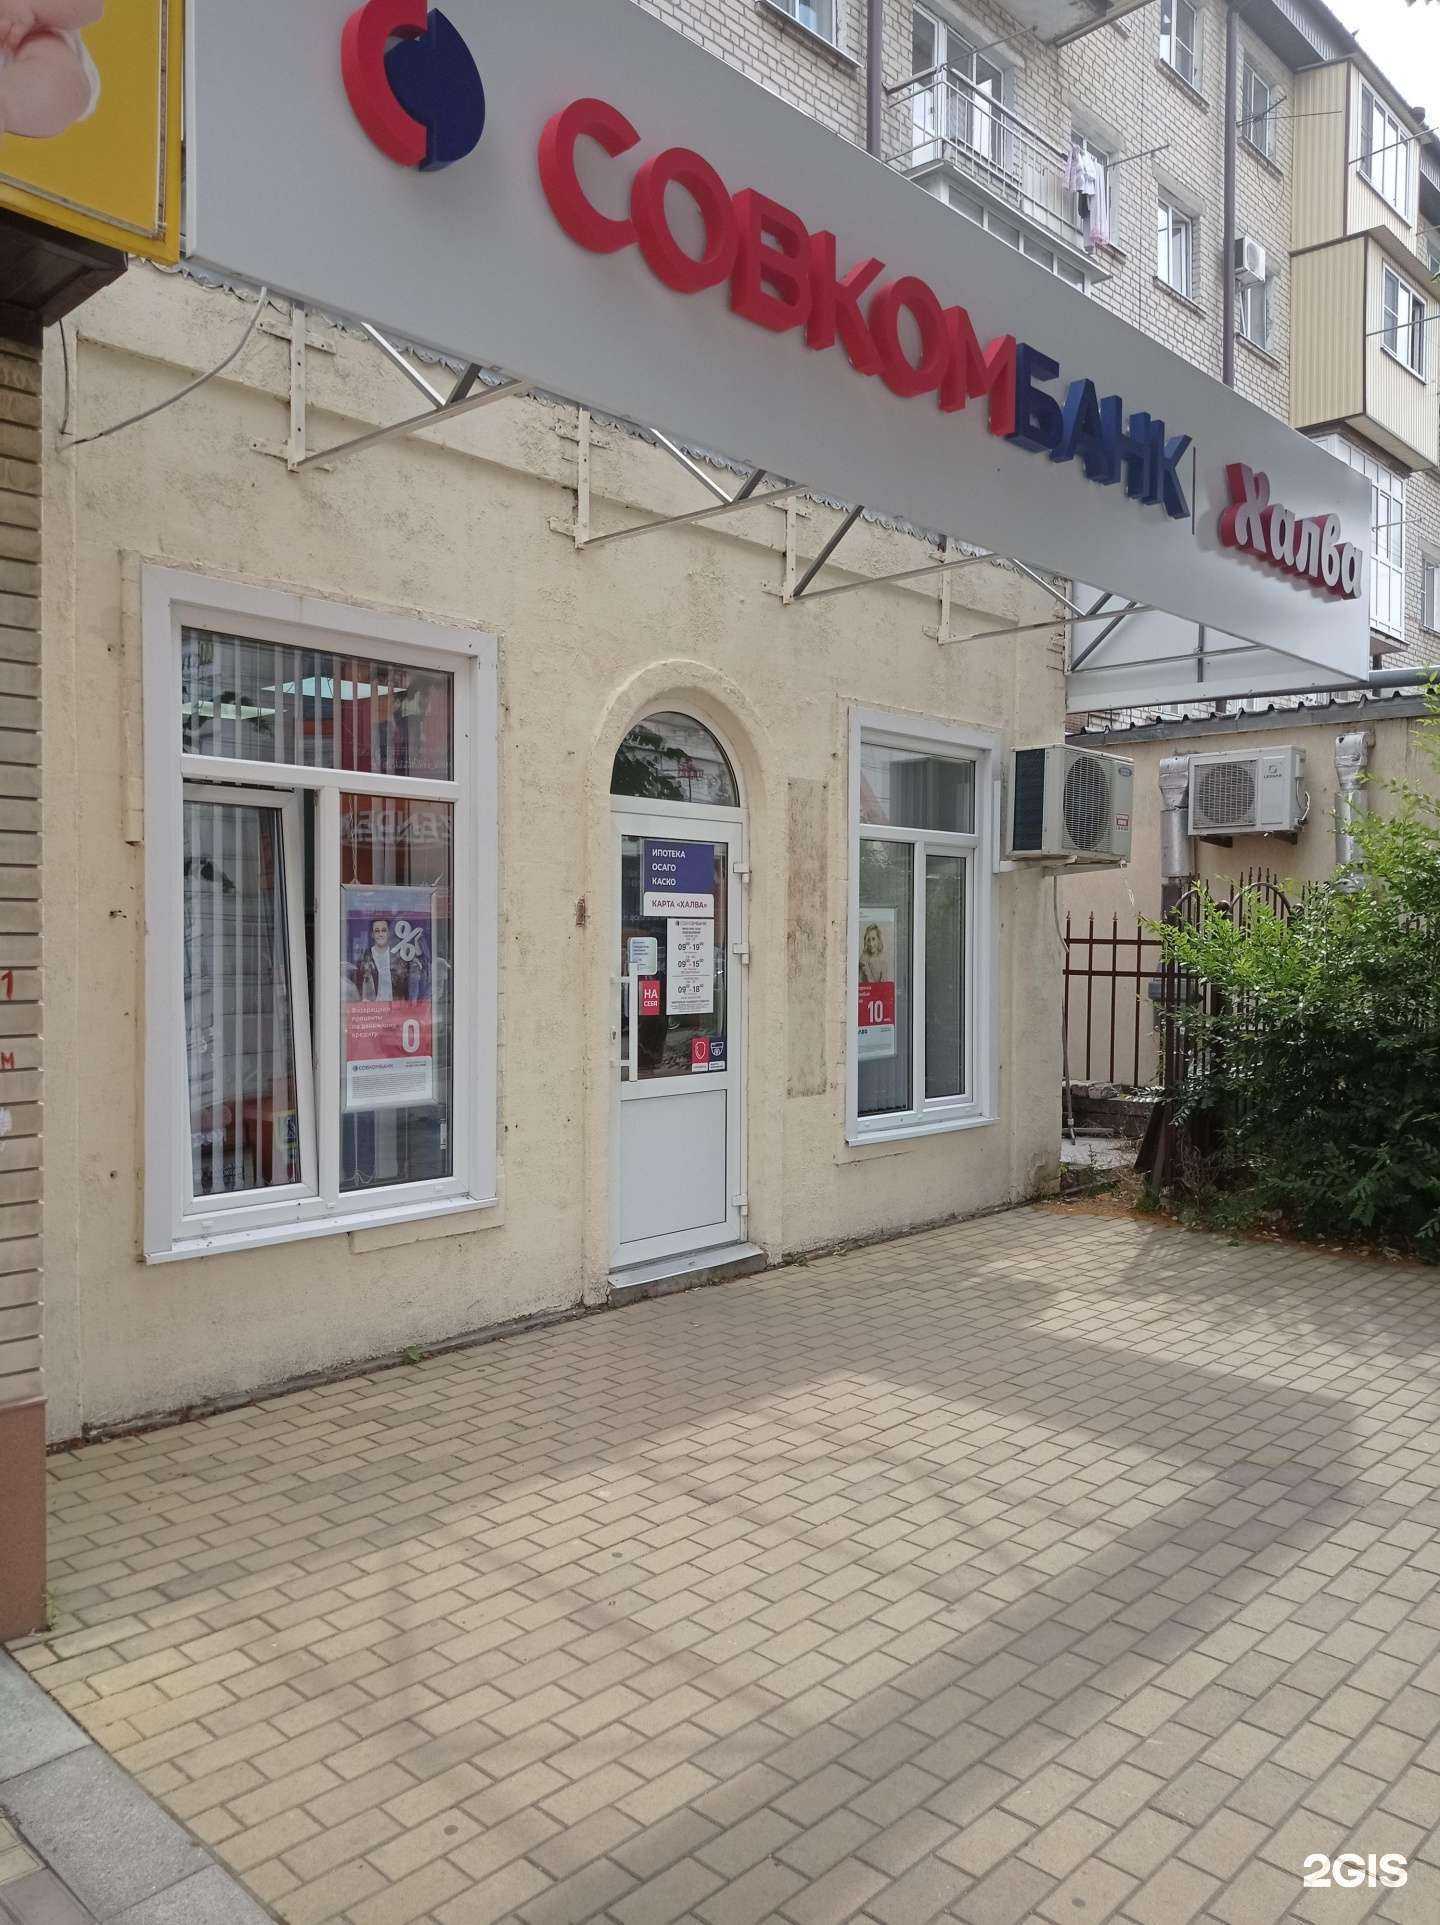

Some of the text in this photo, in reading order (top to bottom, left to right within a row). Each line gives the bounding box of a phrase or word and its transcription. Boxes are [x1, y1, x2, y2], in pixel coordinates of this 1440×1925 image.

[538, 97, 1193, 520] СОВКОМБАНК
[1219, 463, 1363, 600] Халва
[652, 849, 686, 858] ИПОТЕКА
[652, 863, 677, 872] ОСАГО
[652, 877, 677, 886] КАСКО
[652, 899, 675, 908] КАРТА
[644, 989, 658, 999] НА
[867, 1000, 884, 1024] 10
